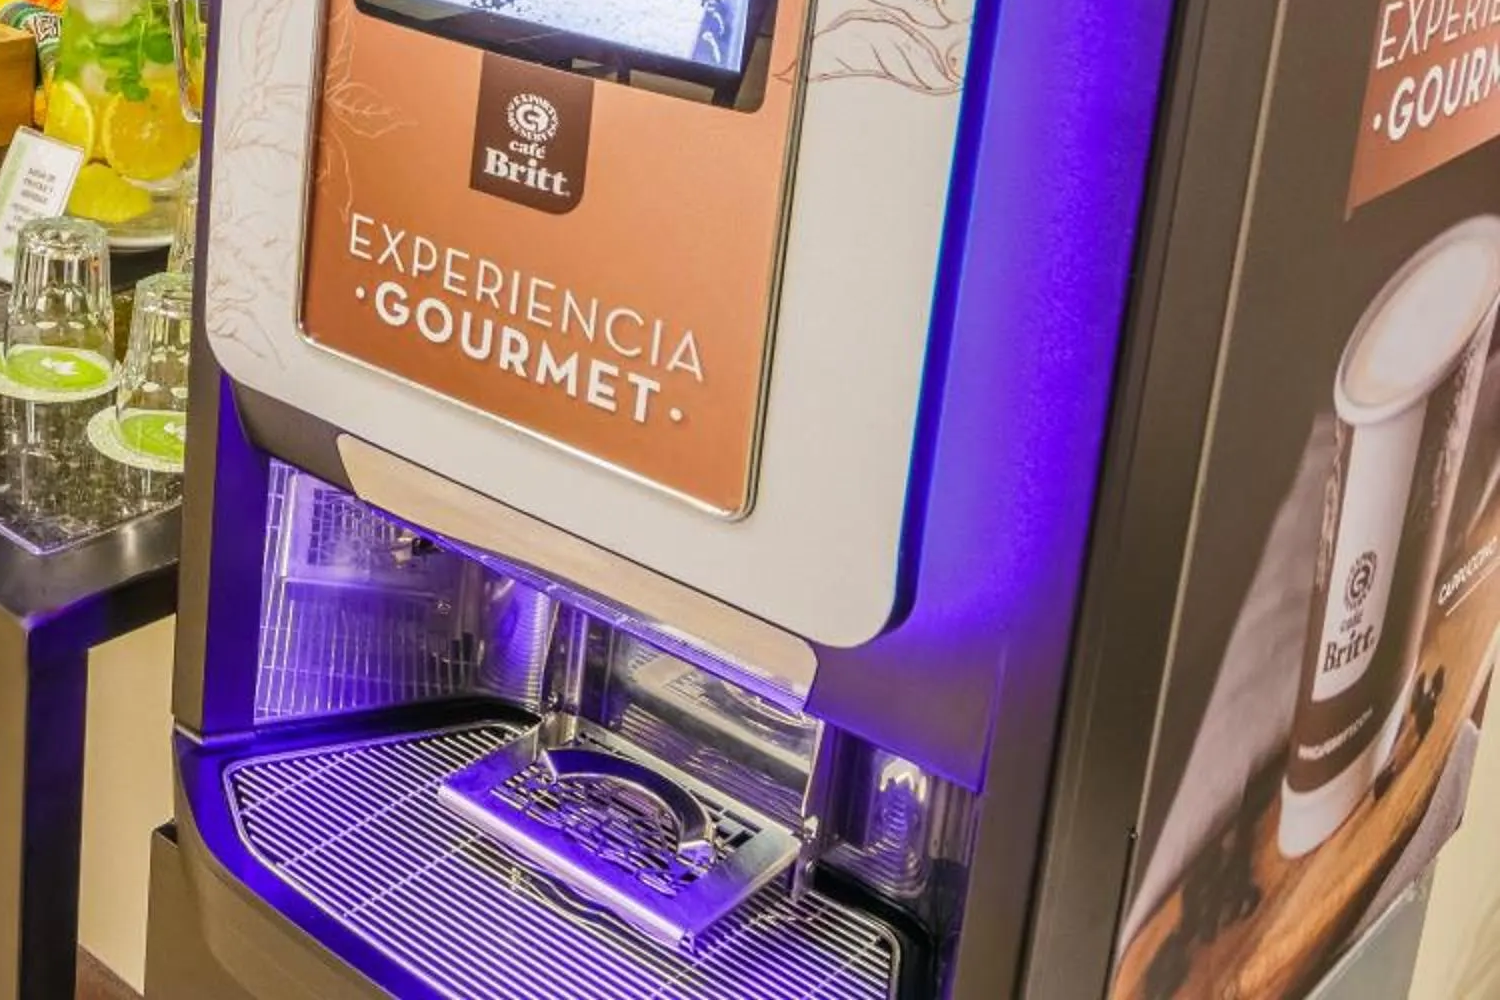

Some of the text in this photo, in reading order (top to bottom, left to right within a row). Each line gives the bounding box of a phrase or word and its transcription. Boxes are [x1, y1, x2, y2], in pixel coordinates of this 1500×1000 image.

[484, 146, 568, 196] Britt
[509, 140, 546, 160] café
[349, 212, 704, 382] EXPERIENCIA
[1323, 624, 1375, 674] Britt
